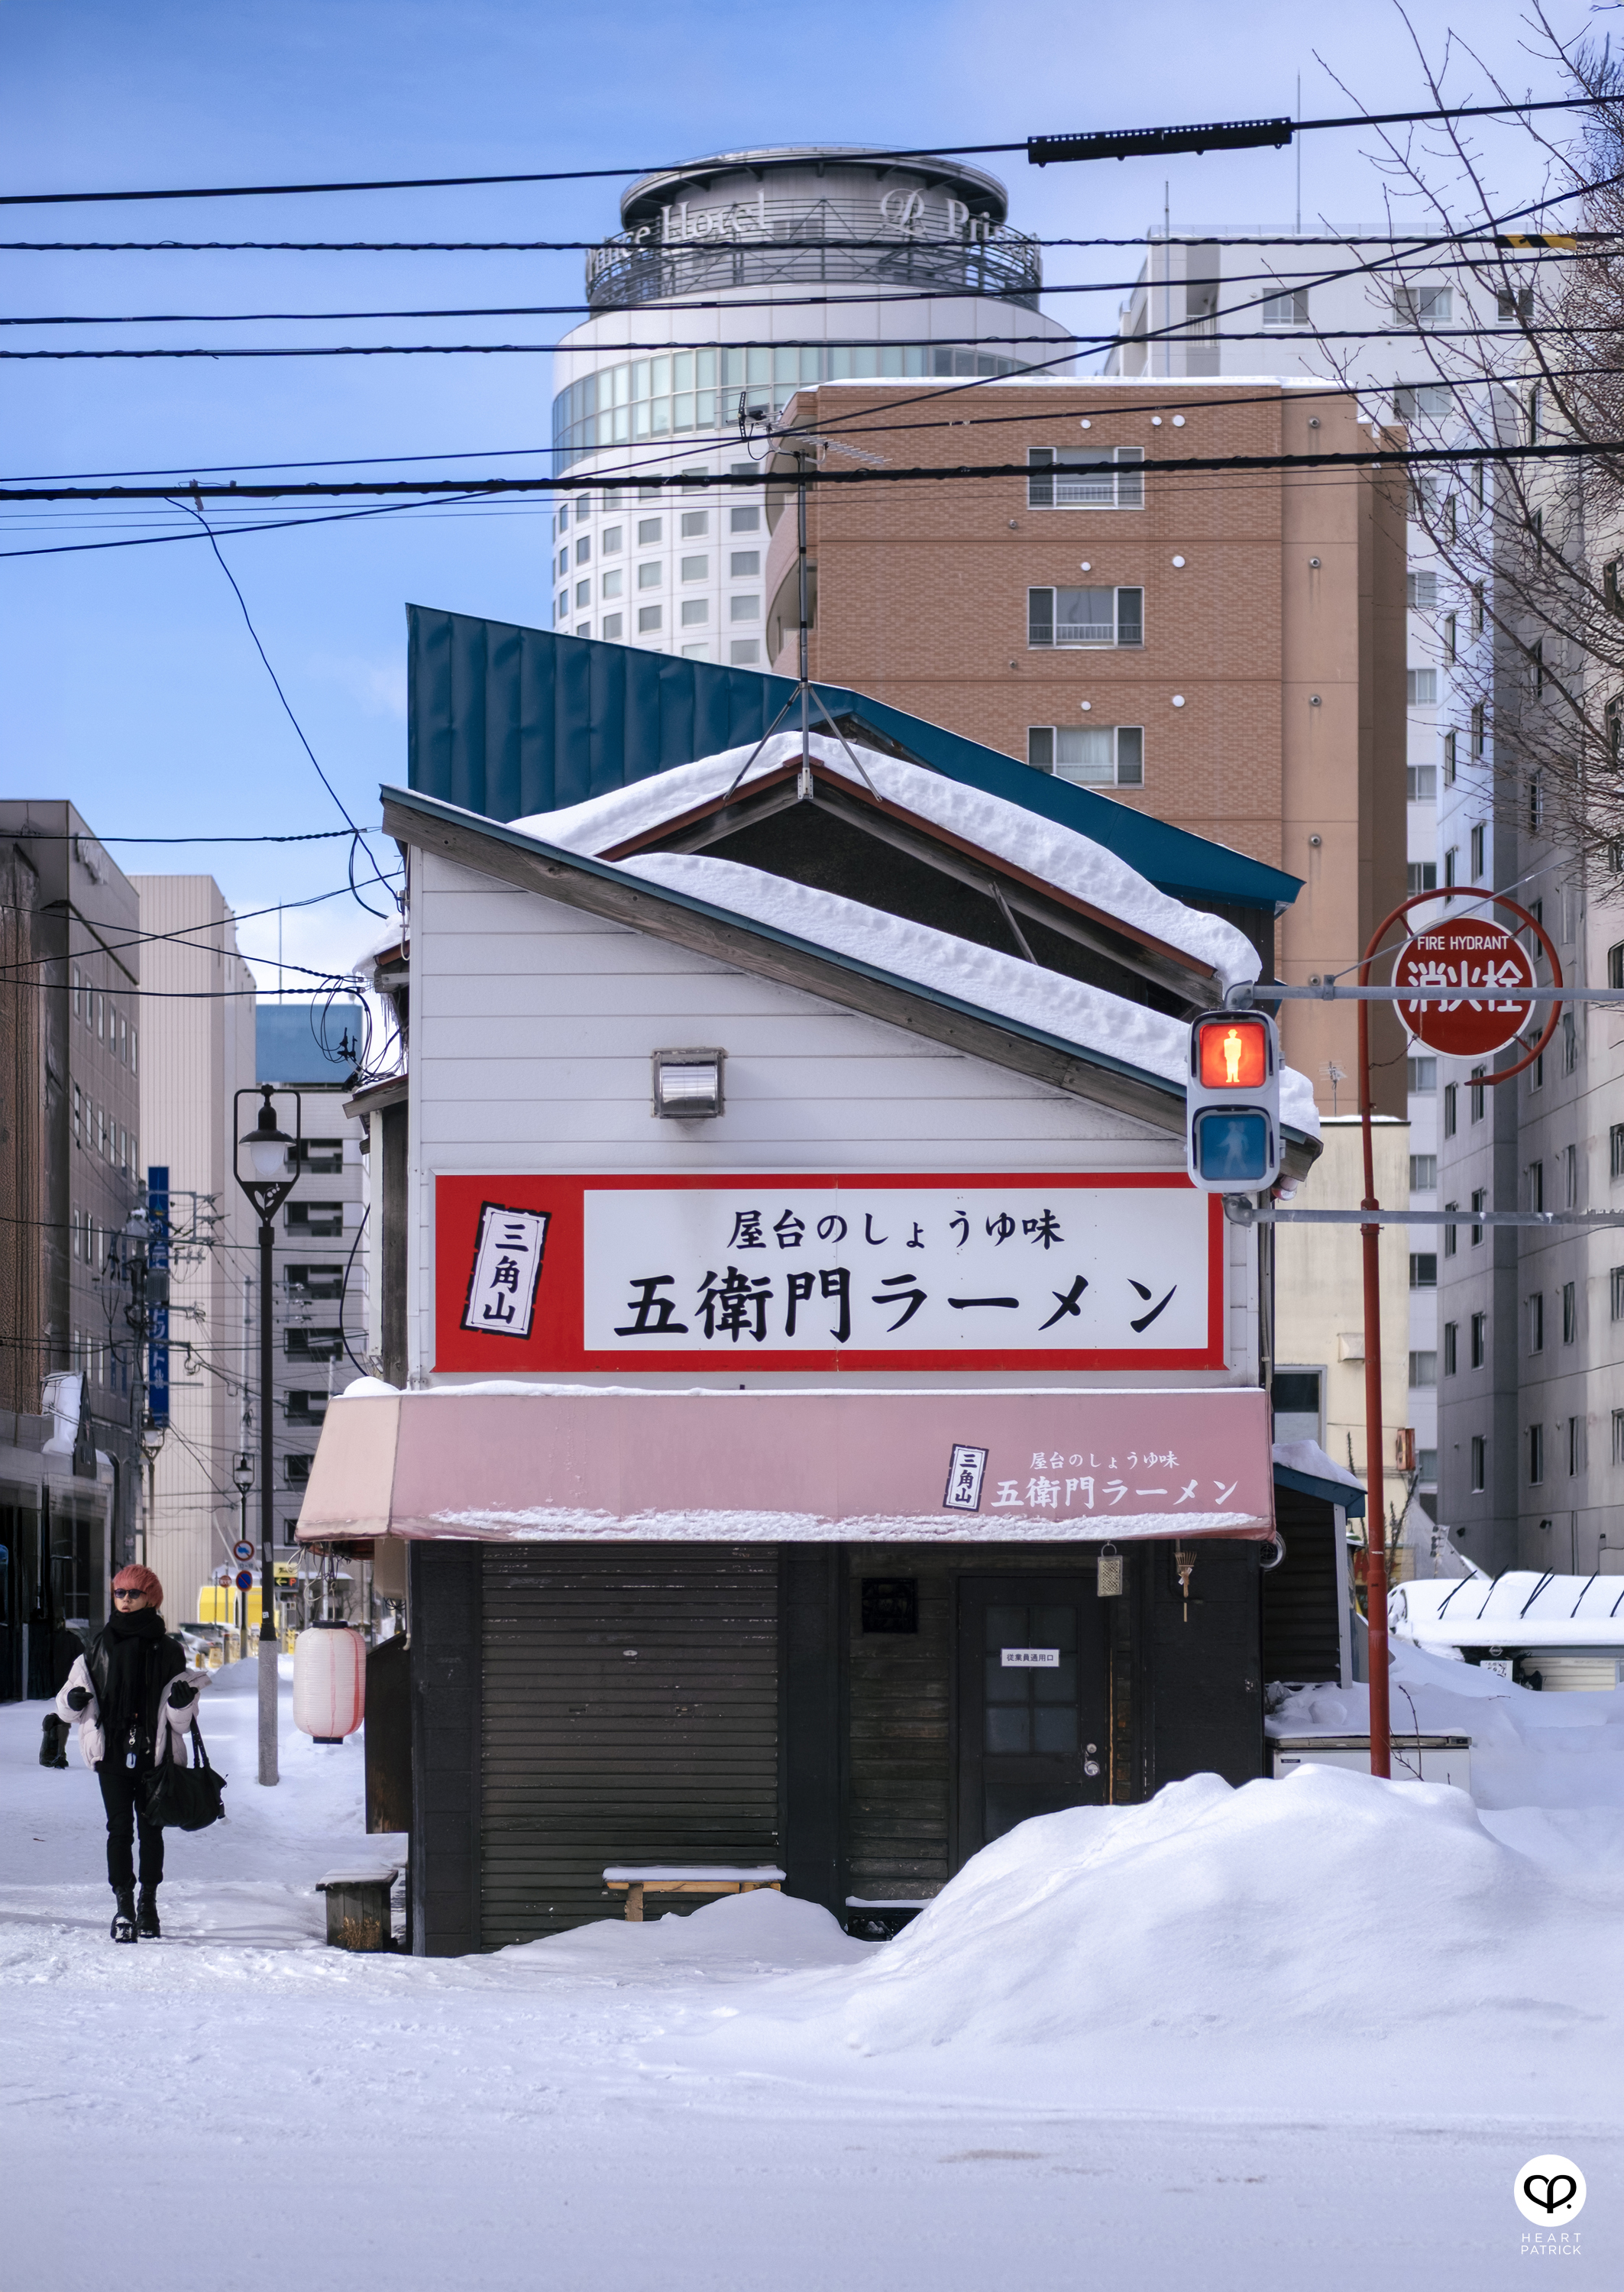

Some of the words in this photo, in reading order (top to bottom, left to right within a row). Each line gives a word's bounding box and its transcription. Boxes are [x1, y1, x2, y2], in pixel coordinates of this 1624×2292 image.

[660, 188, 767, 244] Hotel
[1417, 936, 1445, 950] FIRE
[1449, 935, 1509, 950] HYDRANT
[1407, 960, 1524, 1013] 消火栓
[726, 1208, 1066, 1251] 屋台のしょうゆ味
[482, 1222, 530, 1325] 三角山
[613, 1265, 1178, 1344] 五衛門ラーメン
[954, 1452, 979, 1504] 三角山
[1029, 1450, 1181, 1470] 屋台のしょうゆ味
[990, 1475, 1239, 1510] 五衛門ラーメン
[289, 1578, 297, 1587] P
[1006, 1653, 1054, 1662] 従業員通用口
